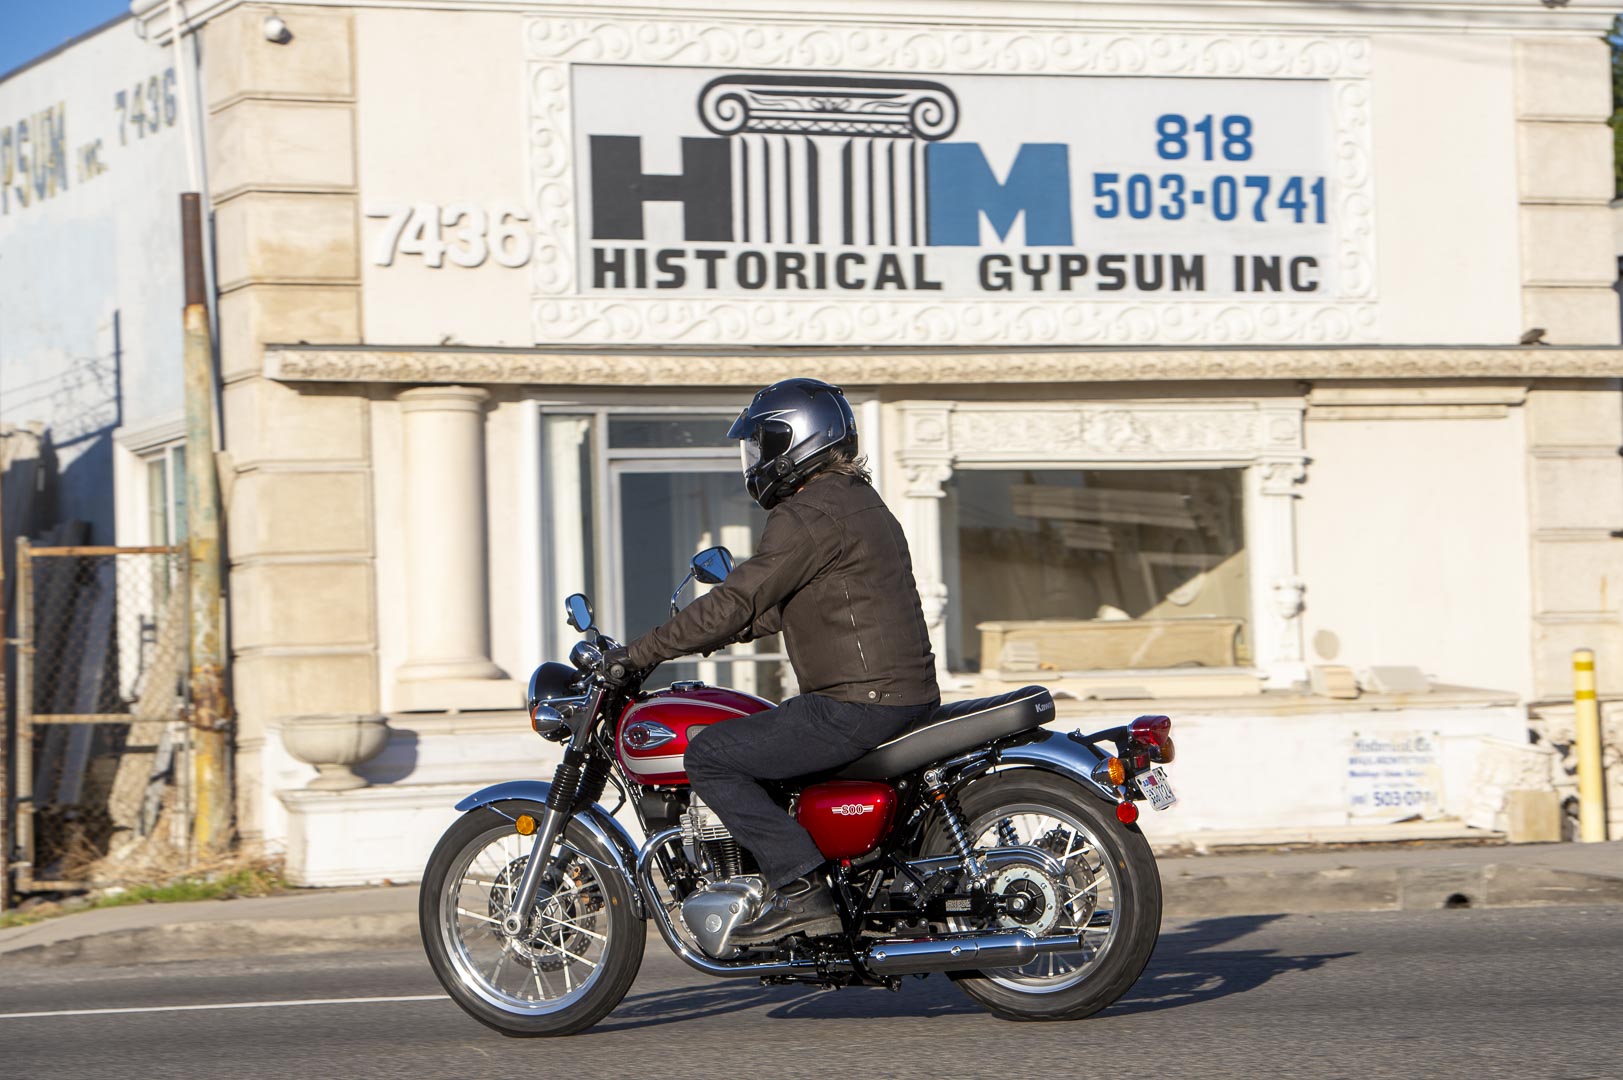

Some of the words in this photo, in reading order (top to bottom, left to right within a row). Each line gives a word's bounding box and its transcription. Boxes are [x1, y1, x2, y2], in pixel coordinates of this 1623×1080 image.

[114, 67, 177, 146] 7436
[1156, 114, 1253, 161] 818
[1093, 173, 1327, 224] 503-0741
[366, 201, 533, 269] 7436
[592, 248, 943, 290] HISTORICAL
[978, 254, 1205, 292] GYPSUM
[1233, 256, 1319, 292] INC
